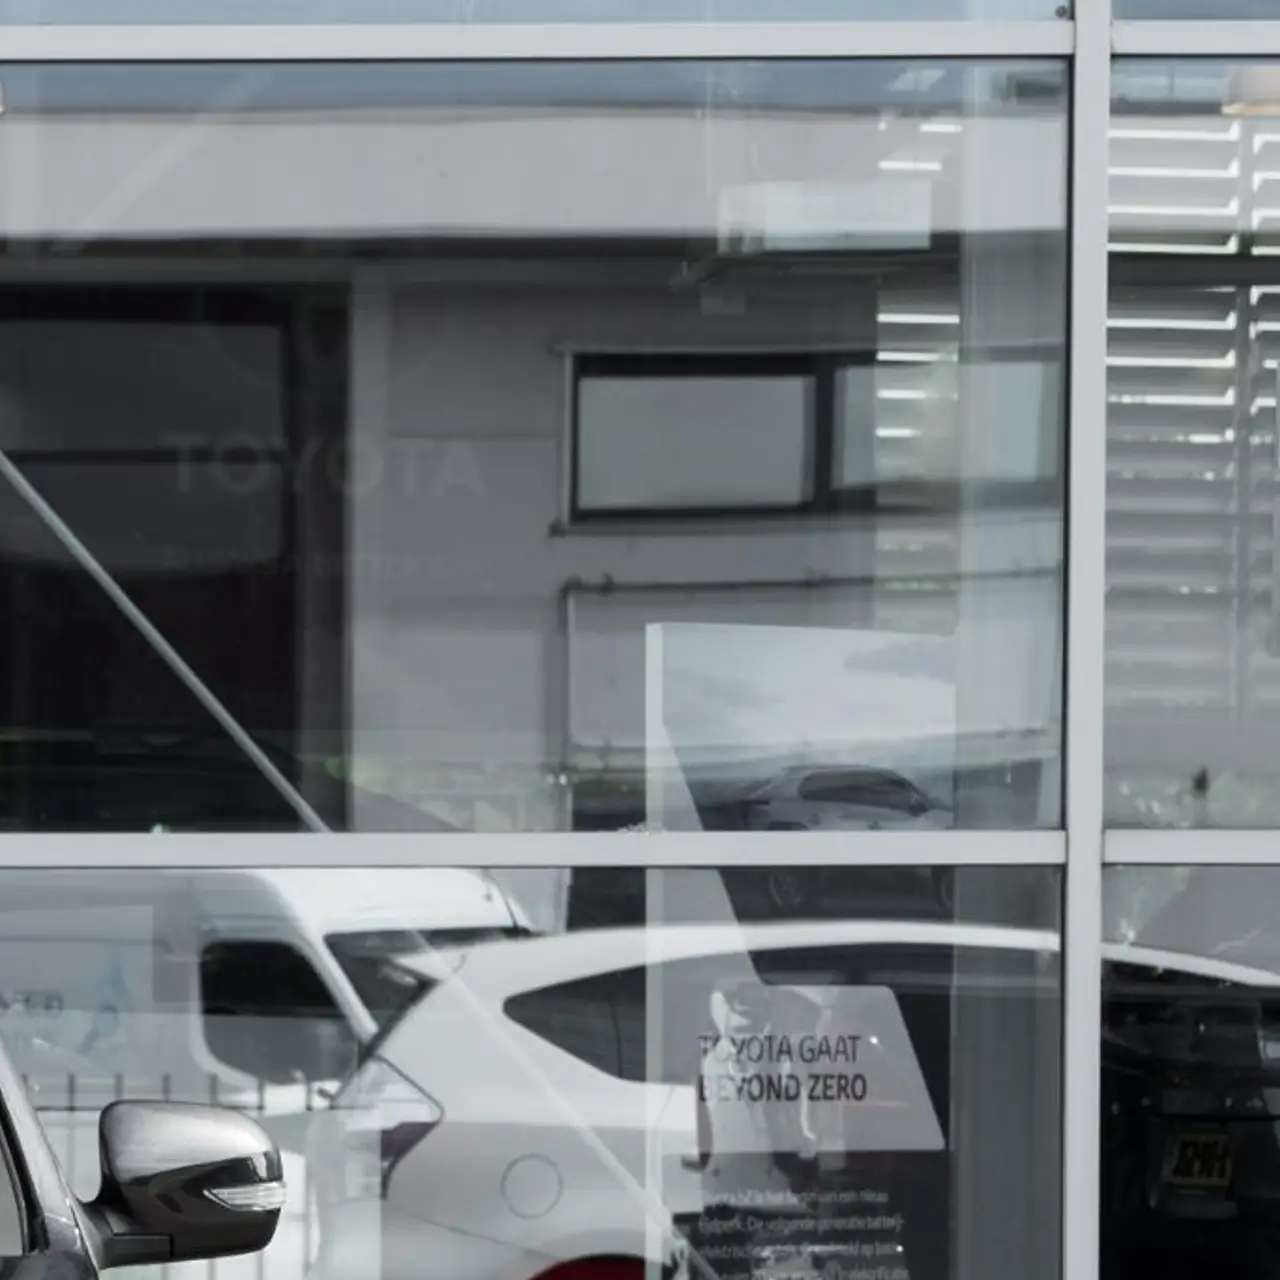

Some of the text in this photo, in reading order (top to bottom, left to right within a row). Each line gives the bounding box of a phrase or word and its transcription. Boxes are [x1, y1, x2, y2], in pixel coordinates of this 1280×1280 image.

[158, 431, 488, 496] TOYOTA
[697, 1035, 861, 1063] TYOTA GAAT
[807, 1073, 867, 1102] ZERO
